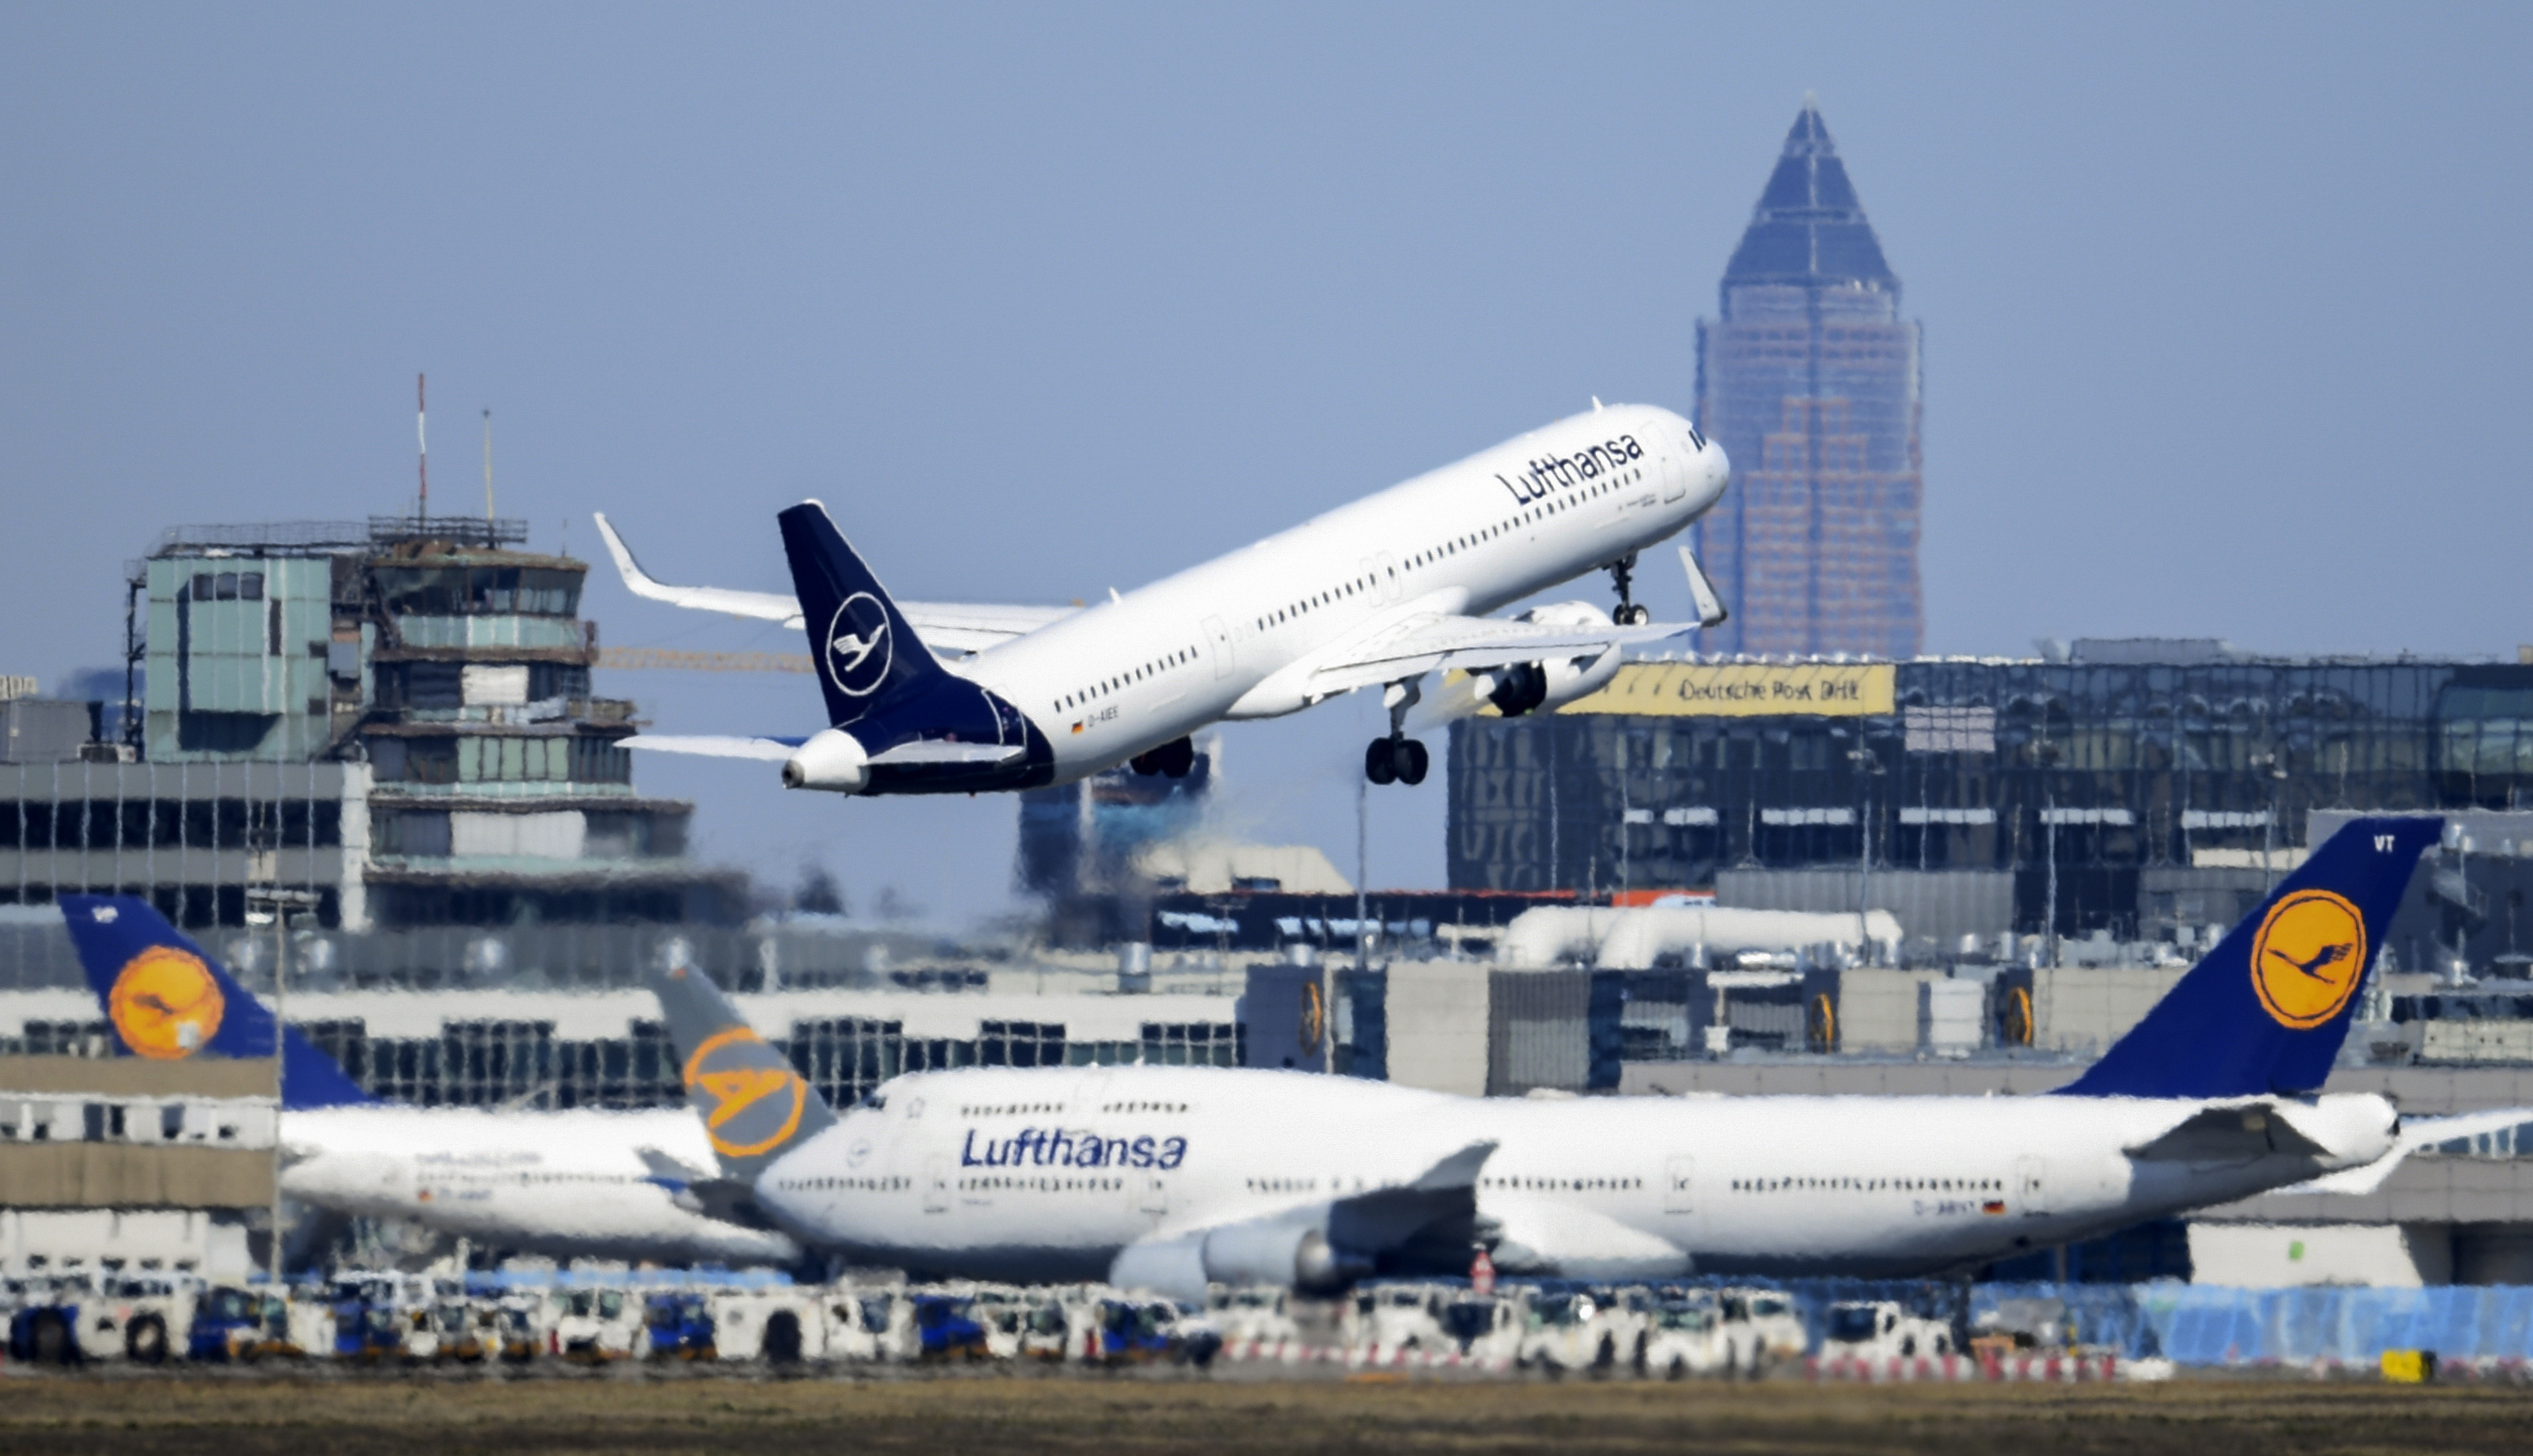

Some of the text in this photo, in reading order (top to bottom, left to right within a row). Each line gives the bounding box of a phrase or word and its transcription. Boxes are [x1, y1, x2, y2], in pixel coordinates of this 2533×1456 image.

[1495, 434, 1644, 506] Lufthansa
[1679, 679, 1767, 701] Deutsche
[1772, 680, 1812, 701] Post
[2374, 835, 2395, 852] VT
[961, 1127, 1188, 1170] Lufthansa
